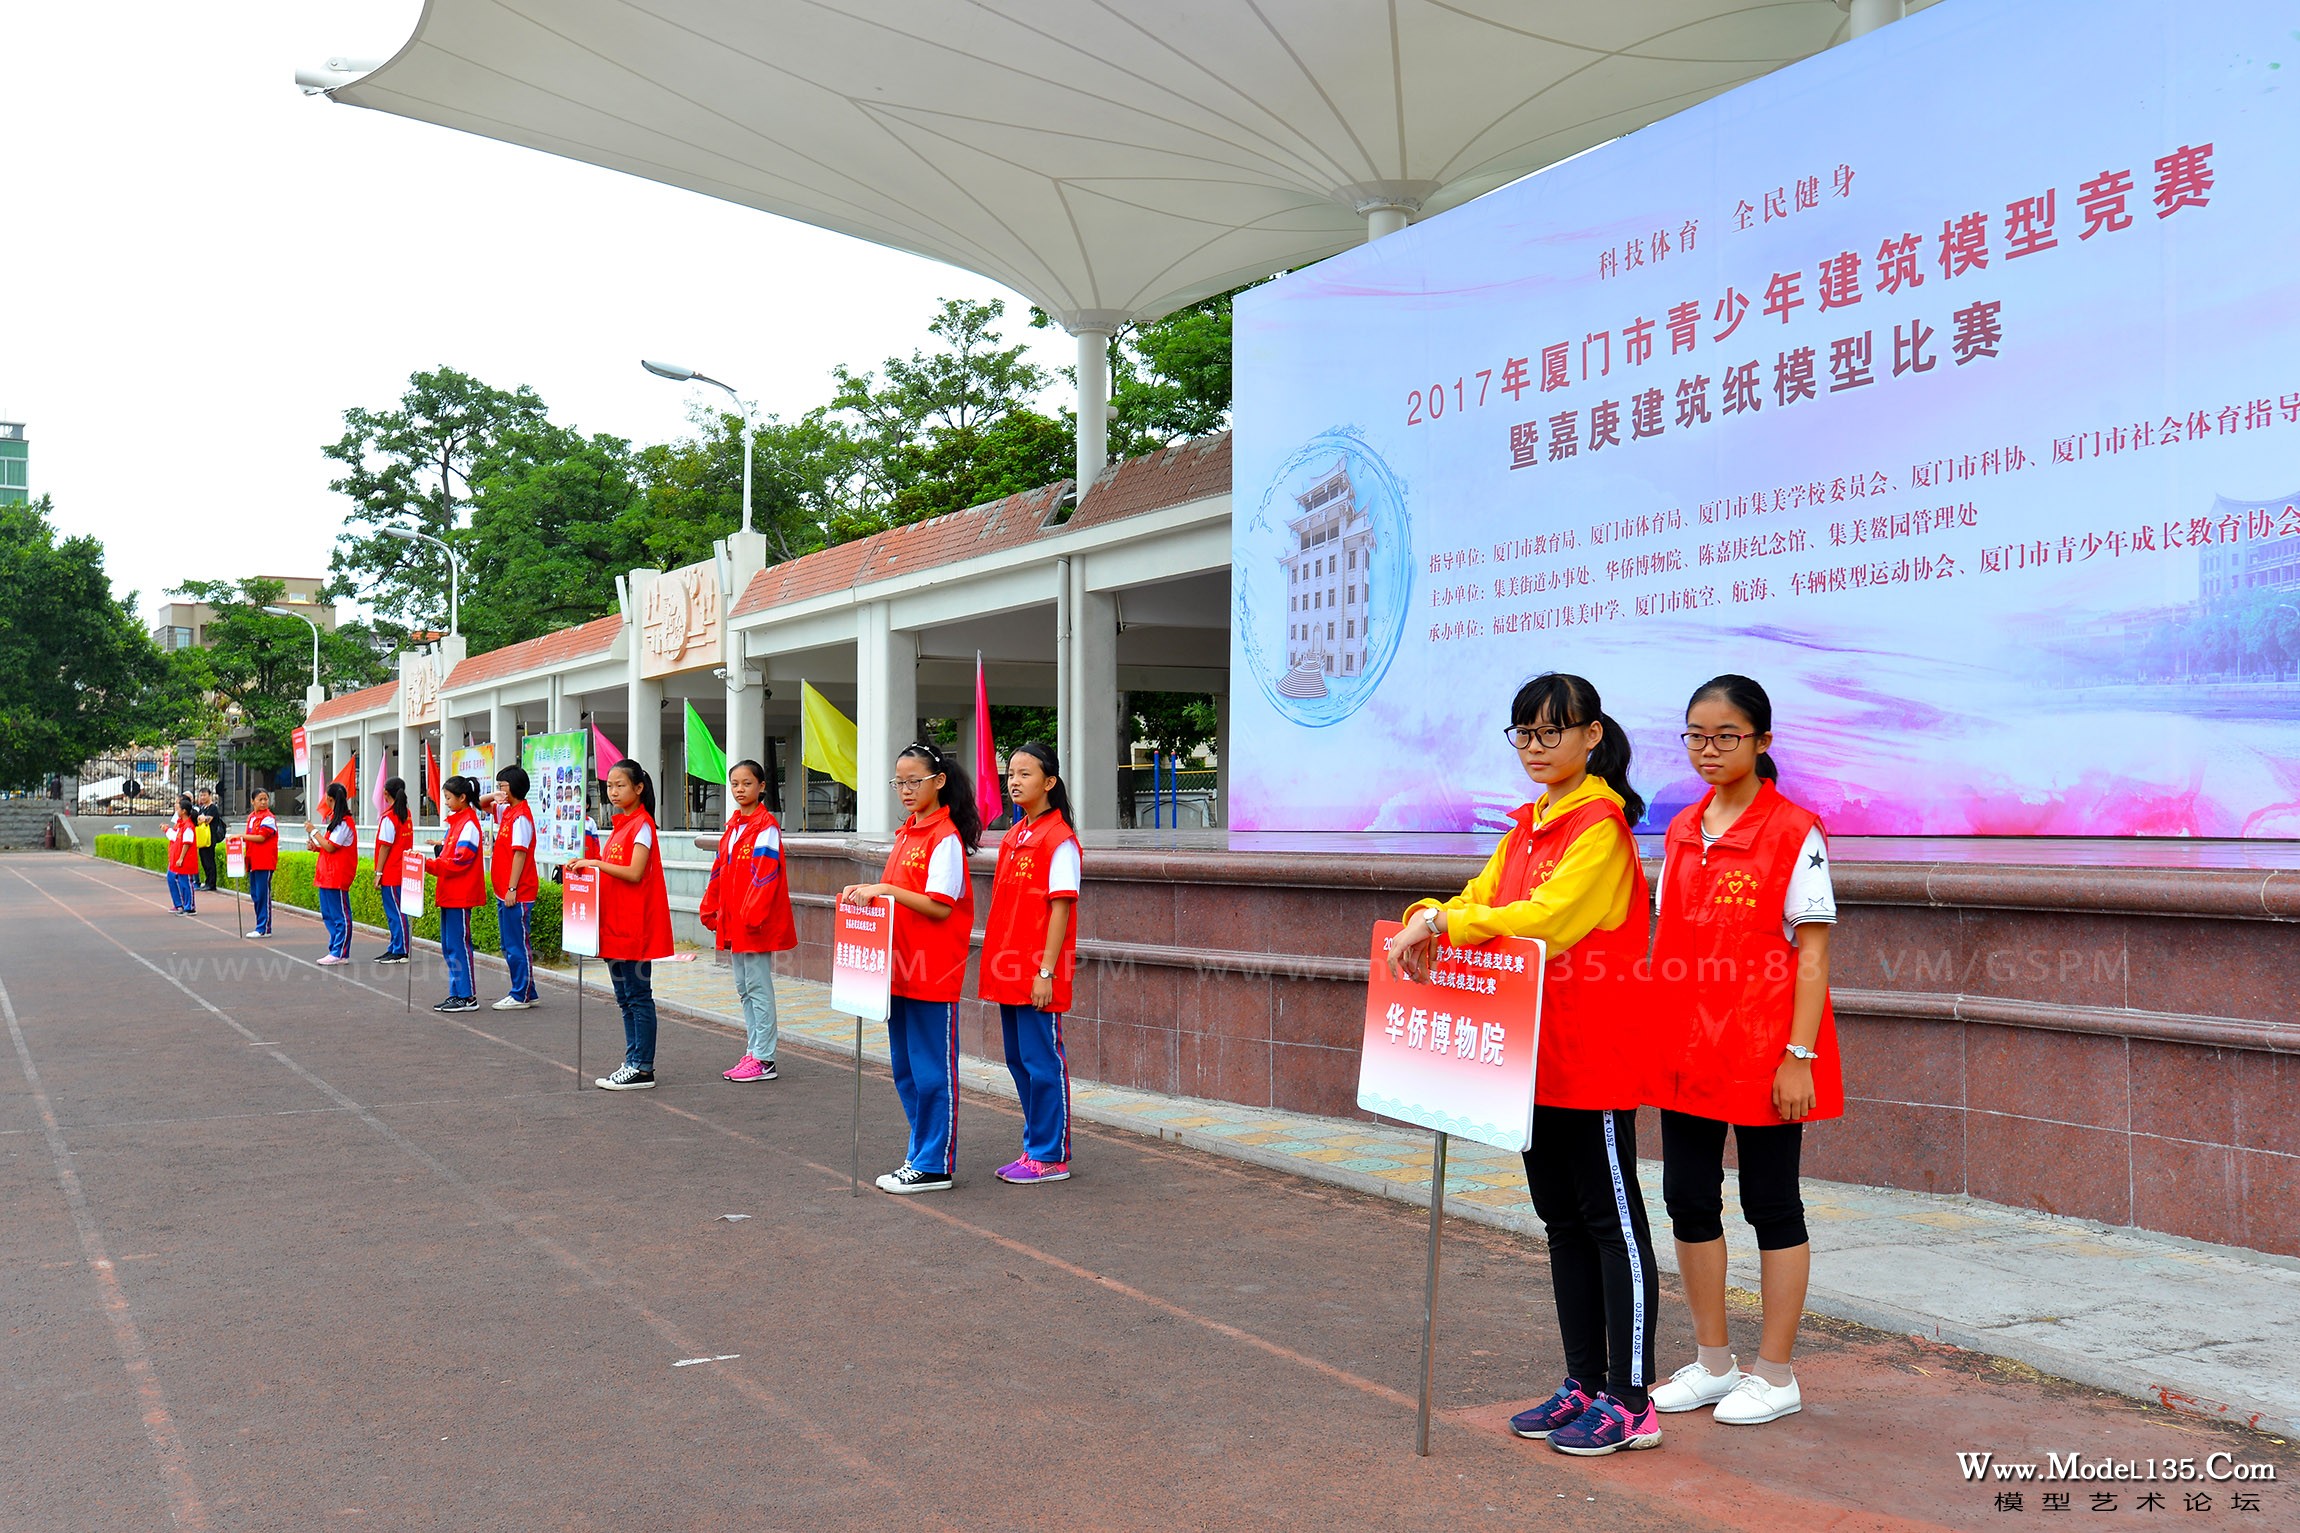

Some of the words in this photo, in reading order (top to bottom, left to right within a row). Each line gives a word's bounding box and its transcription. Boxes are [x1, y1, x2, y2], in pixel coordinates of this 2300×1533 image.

[1598, 219, 1699, 280] 科技体育
[1731, 163, 1856, 233] 全民健身
[1407, 142, 2215, 425] 2017年厦门市青少年建筑模型竞赛
[1509, 300, 2003, 471] 暨嘉庚建筑纸模型比赛
[836, 941, 886, 975] 集美解放纪念碑
[1384, 1002, 1506, 1067] 华侨博物院
